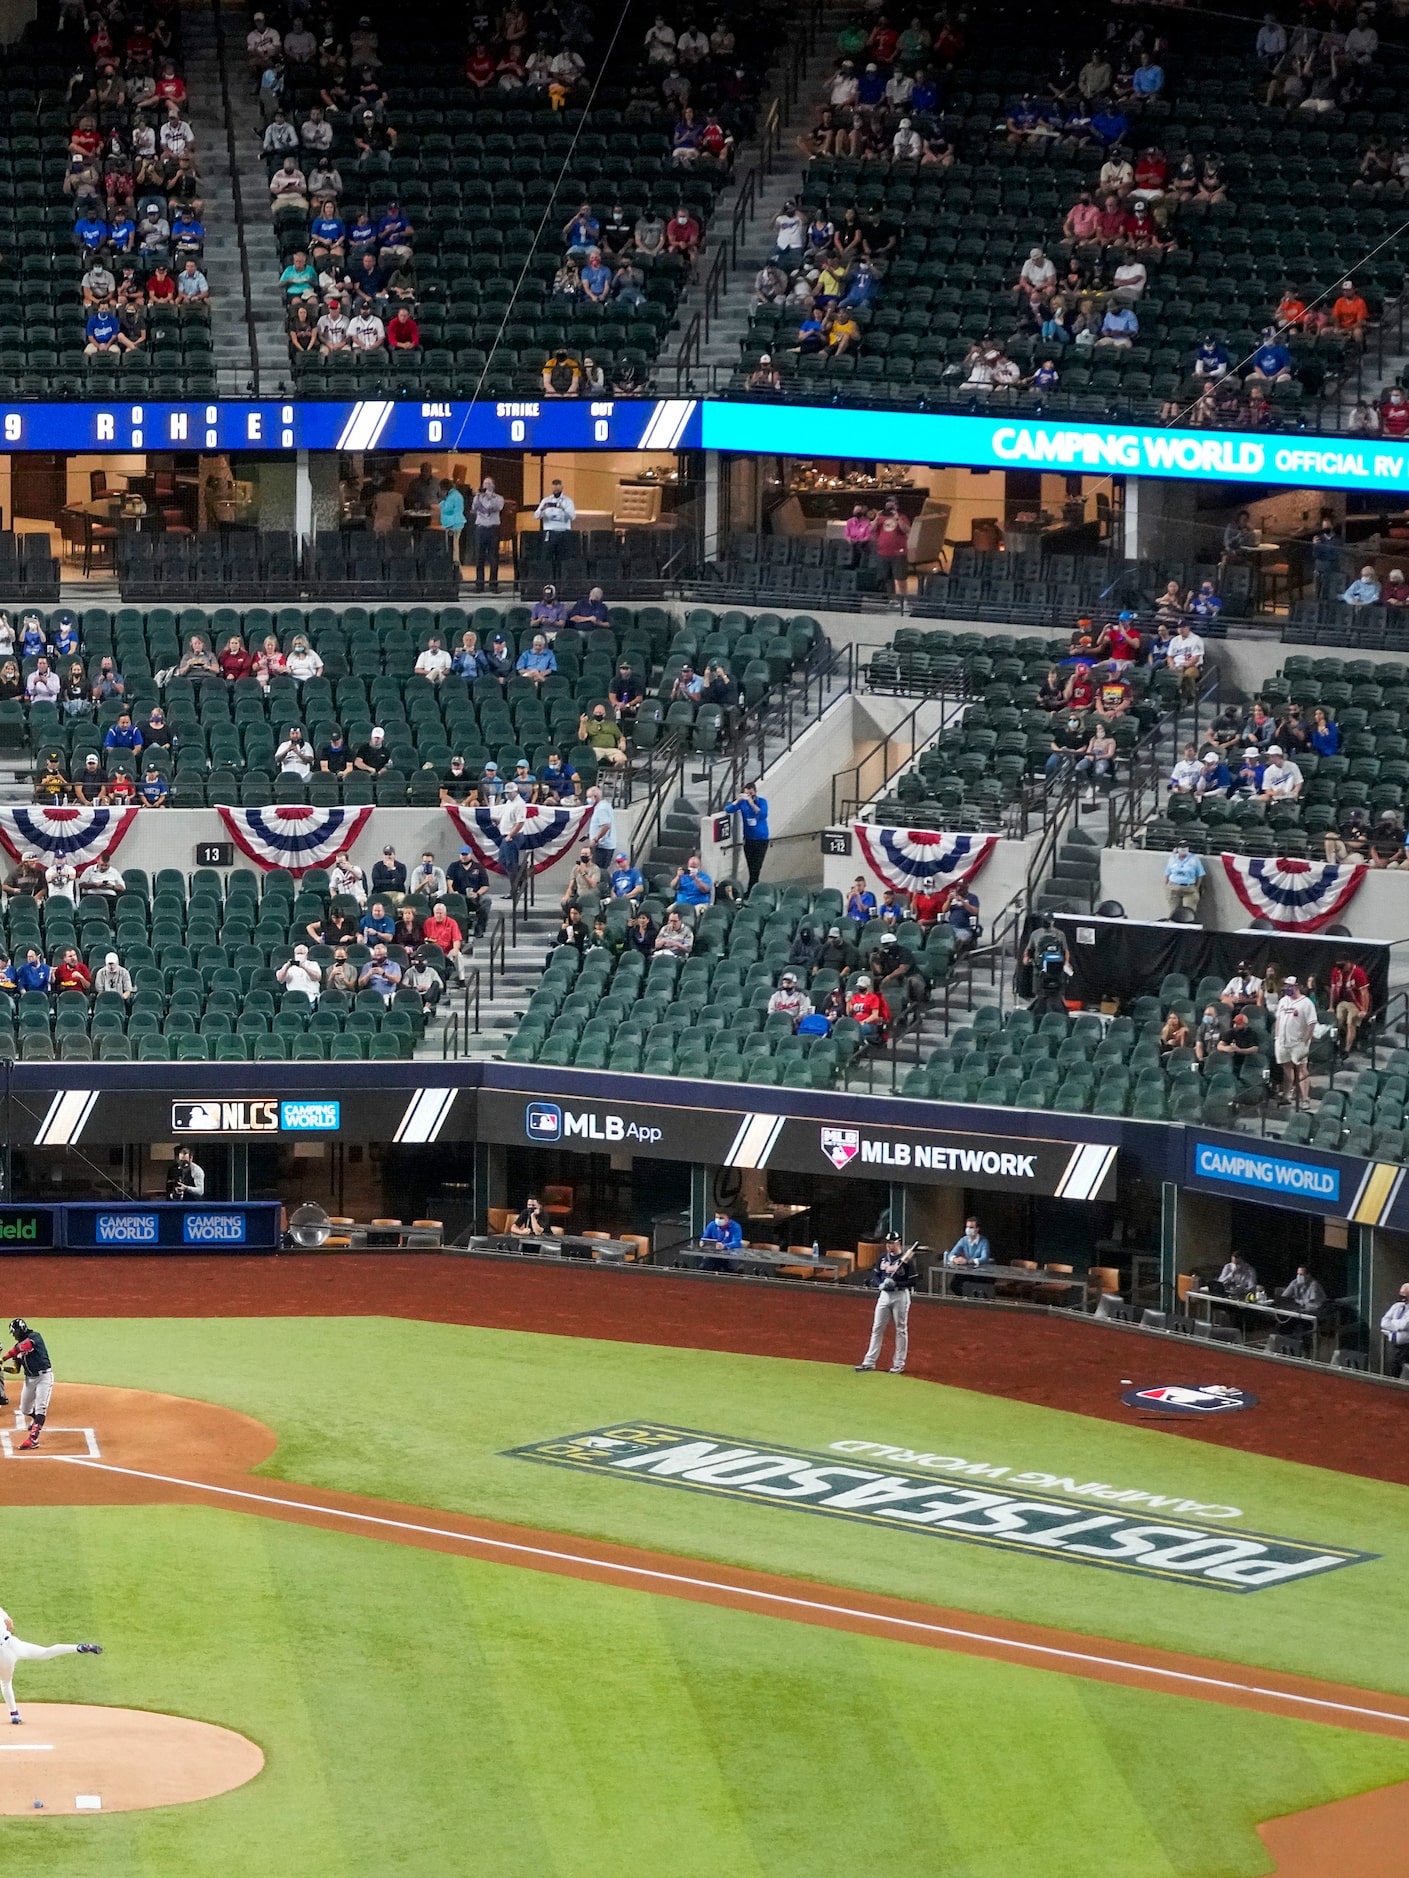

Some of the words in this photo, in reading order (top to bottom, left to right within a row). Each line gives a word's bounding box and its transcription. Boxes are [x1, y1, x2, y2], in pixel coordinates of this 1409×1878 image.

[422, 403, 452, 417] BALL
[496, 403, 540, 417] STRIKE
[591, 402, 614, 416] OUT
[4, 413, 21, 441] 9
[96, 413, 114, 440] R
[170, 413, 187, 439] H
[247, 413, 262, 440] E
[428, 420, 442, 442] 0
[510, 420, 525, 441] 0
[594, 420, 609, 441] 0
[991, 427, 1140, 467] CAMPING
[1142, 437, 1265, 474] WORLD
[1275, 449, 1369, 476] OFFICIAL
[1374, 456, 1402, 478] RV
[204, 847, 220, 862] 13
[222, 1102, 279, 1130] NLCS
[283, 1104, 337, 1115] CAMPING
[285, 1115, 337, 1128] WORLD
[563, 1111, 625, 1141] MLB
[861, 1140, 912, 1167] MLB
[914, 1145, 1036, 1178] NETWORK
[1200, 1151, 1273, 1183] CAMPING
[1274, 1165, 1335, 1194] WORLD
[99, 1216, 154, 1227] CAMPING
[187, 1216, 242, 1227] CAMPING
[188, 1226, 242, 1239] WORLD
[100, 1227, 155, 1240] WORLD
[828, 1439, 1011, 1480] WORLD
[1006, 1471, 1243, 1518] CAMPING
[610, 1442, 1347, 1587] POSTSEASON
